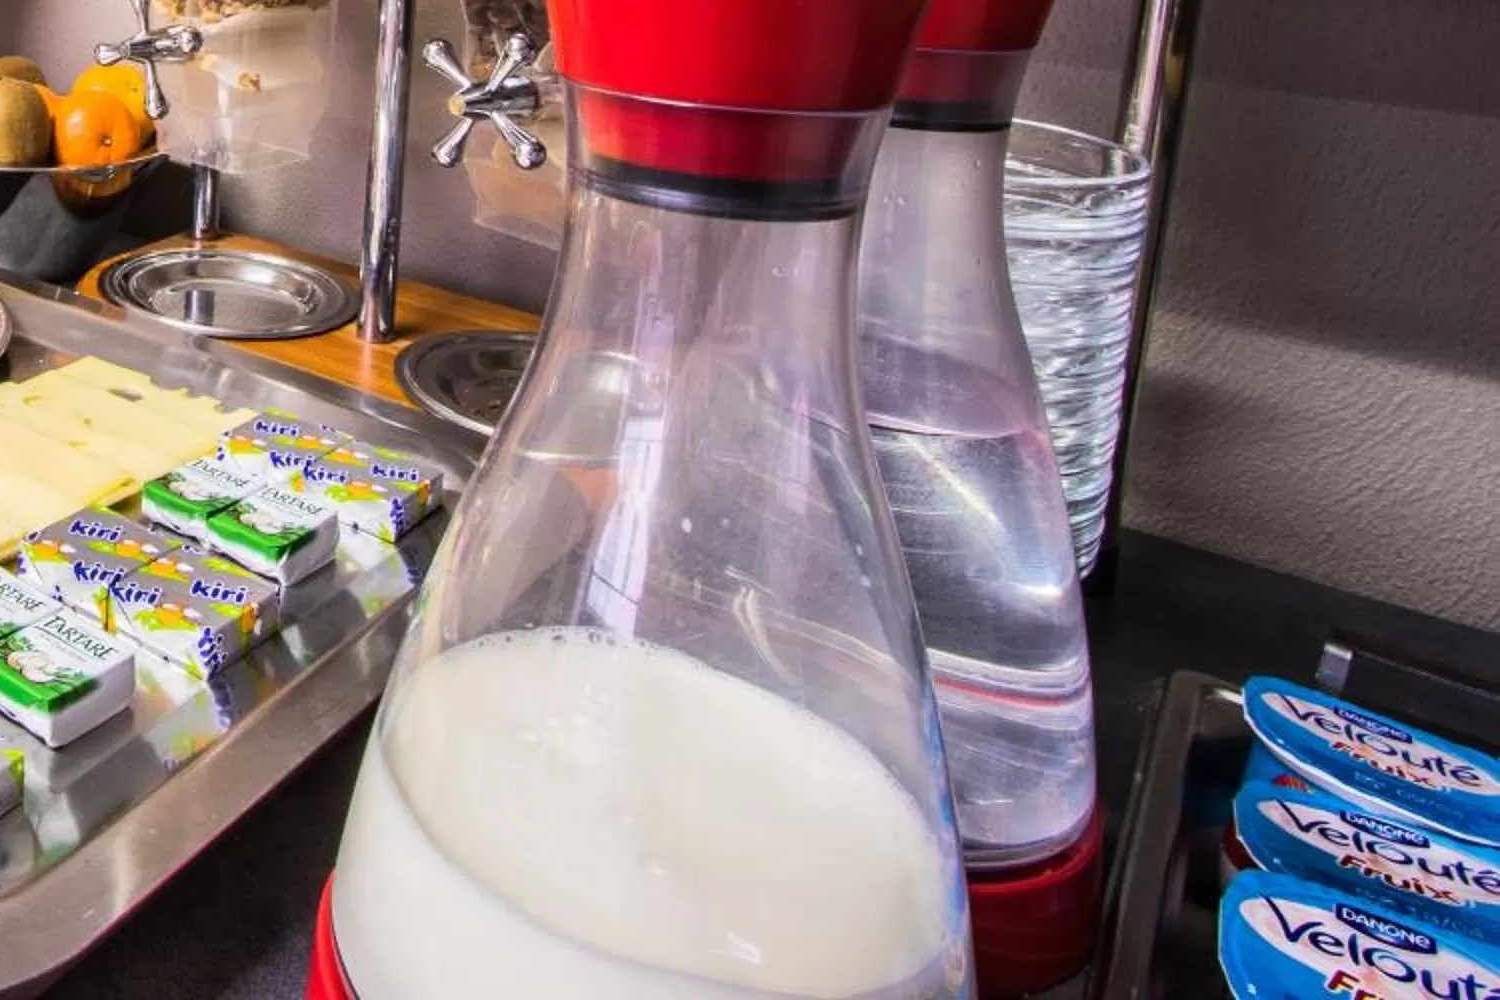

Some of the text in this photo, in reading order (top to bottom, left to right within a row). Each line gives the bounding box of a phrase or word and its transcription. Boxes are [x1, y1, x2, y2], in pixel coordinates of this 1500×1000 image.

[255, 420, 299, 437] kiri
[371, 464, 419, 482] kiri
[70, 519, 124, 541] kiri
[73, 560, 126, 588] kiri
[190, 579, 249, 604] kiri
[109, 582, 162, 605] kiri
[43, 615, 119, 661] TARTARE
[1279, 694, 1481, 788] Velouté
[1275, 799, 1500, 896] Velouté
[1339, 854, 1460, 905] Fruix
[1341, 906, 1431, 950] DANONE
[1262, 895, 1500, 1000] Velout
